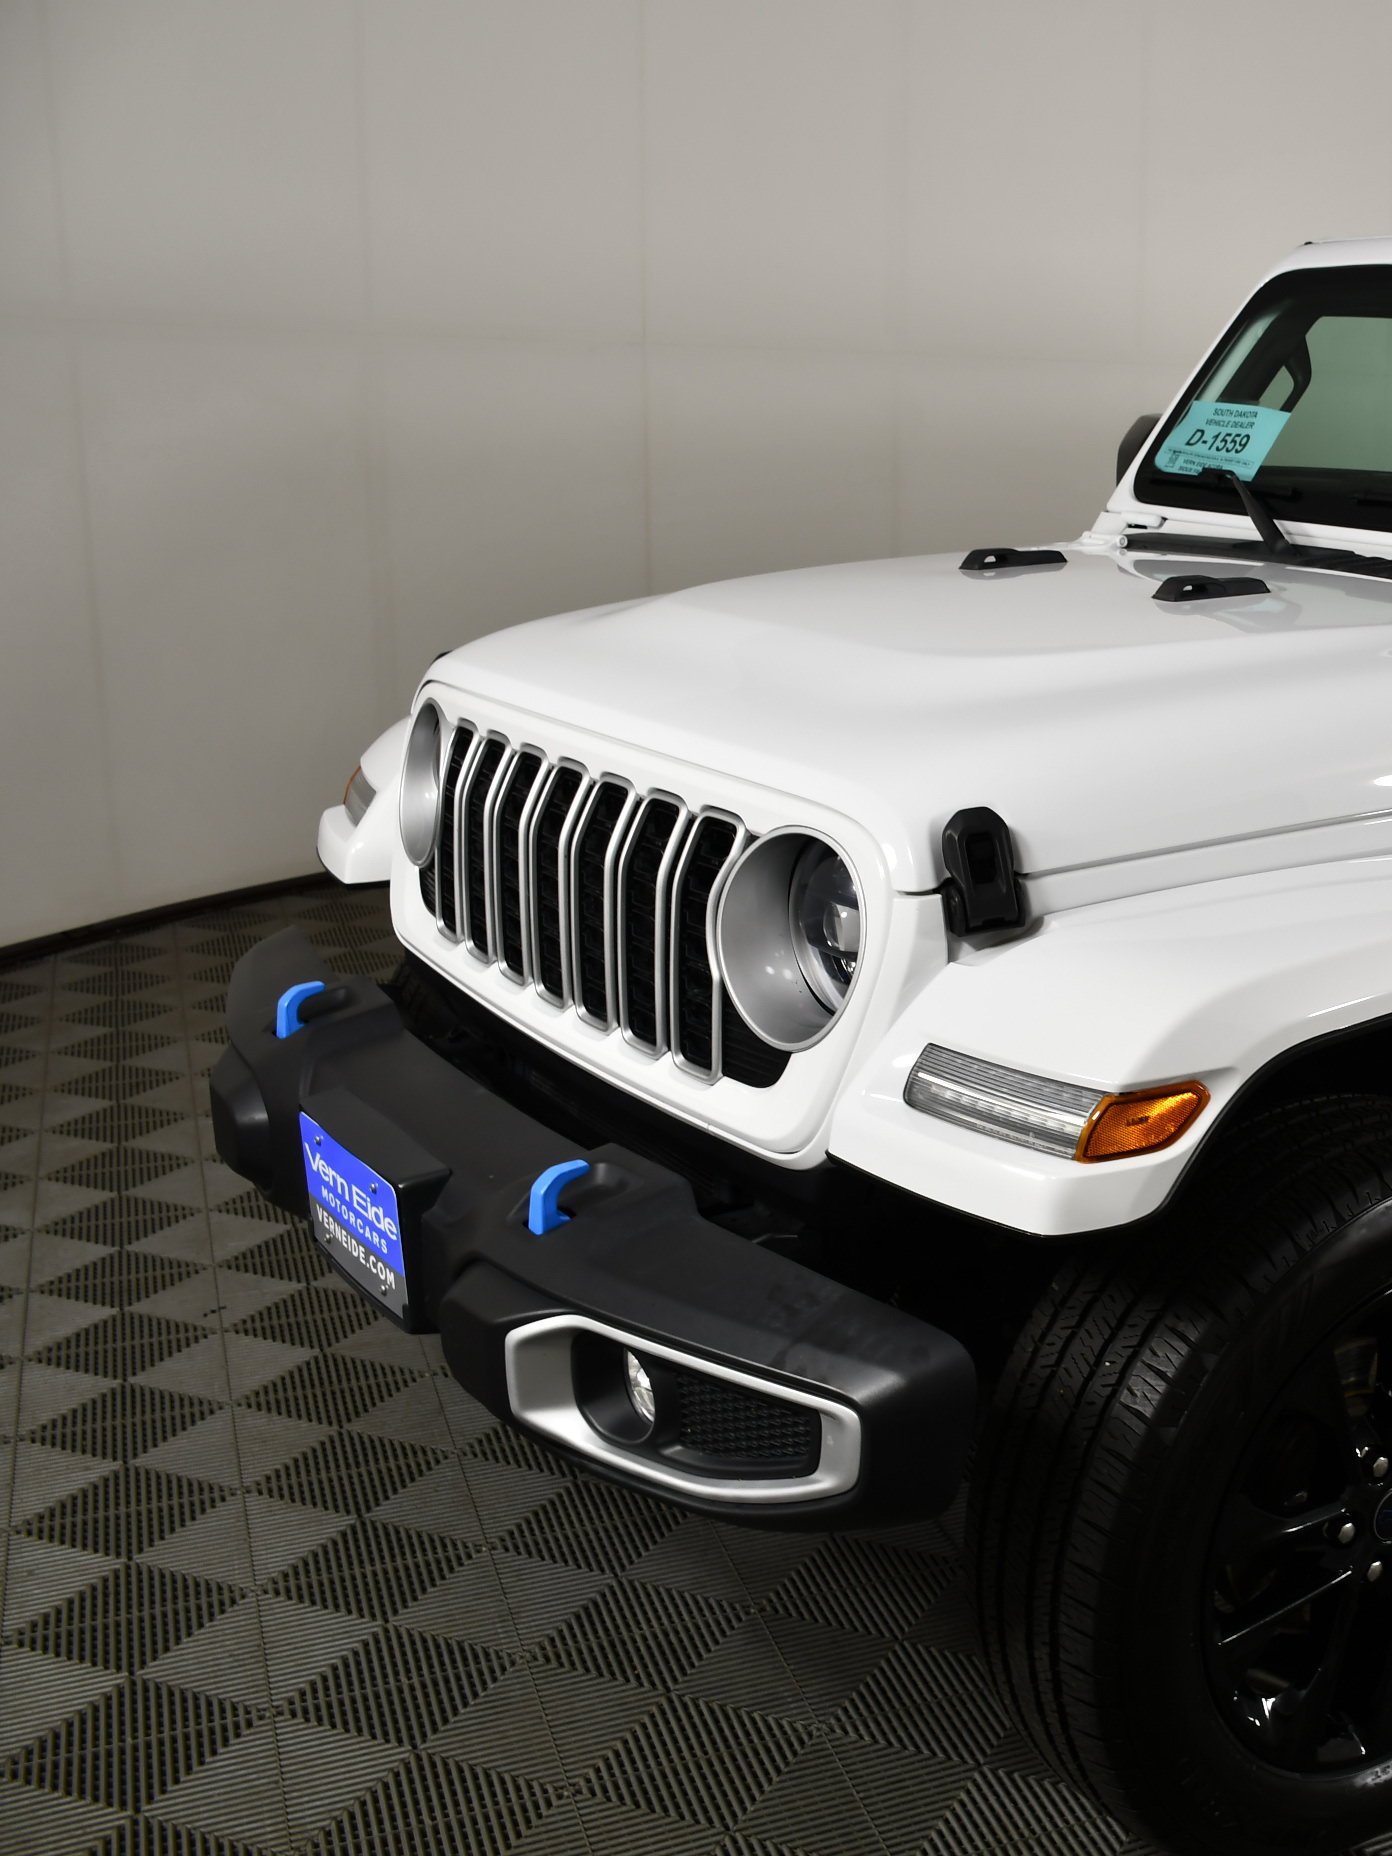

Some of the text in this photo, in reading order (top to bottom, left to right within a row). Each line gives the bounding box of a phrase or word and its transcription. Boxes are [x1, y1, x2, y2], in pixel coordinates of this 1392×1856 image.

[1205, 418, 1255, 430] VEHICLE DEALER
[1212, 407, 1258, 418] SOUTH DAKOTA
[1185, 428, 1251, 454] D-1559
[304, 1142, 398, 1241] Vern Eide
[321, 1185, 388, 1254] MOTORCARS
[316, 1203, 396, 1290] VERNEIDE.COM
